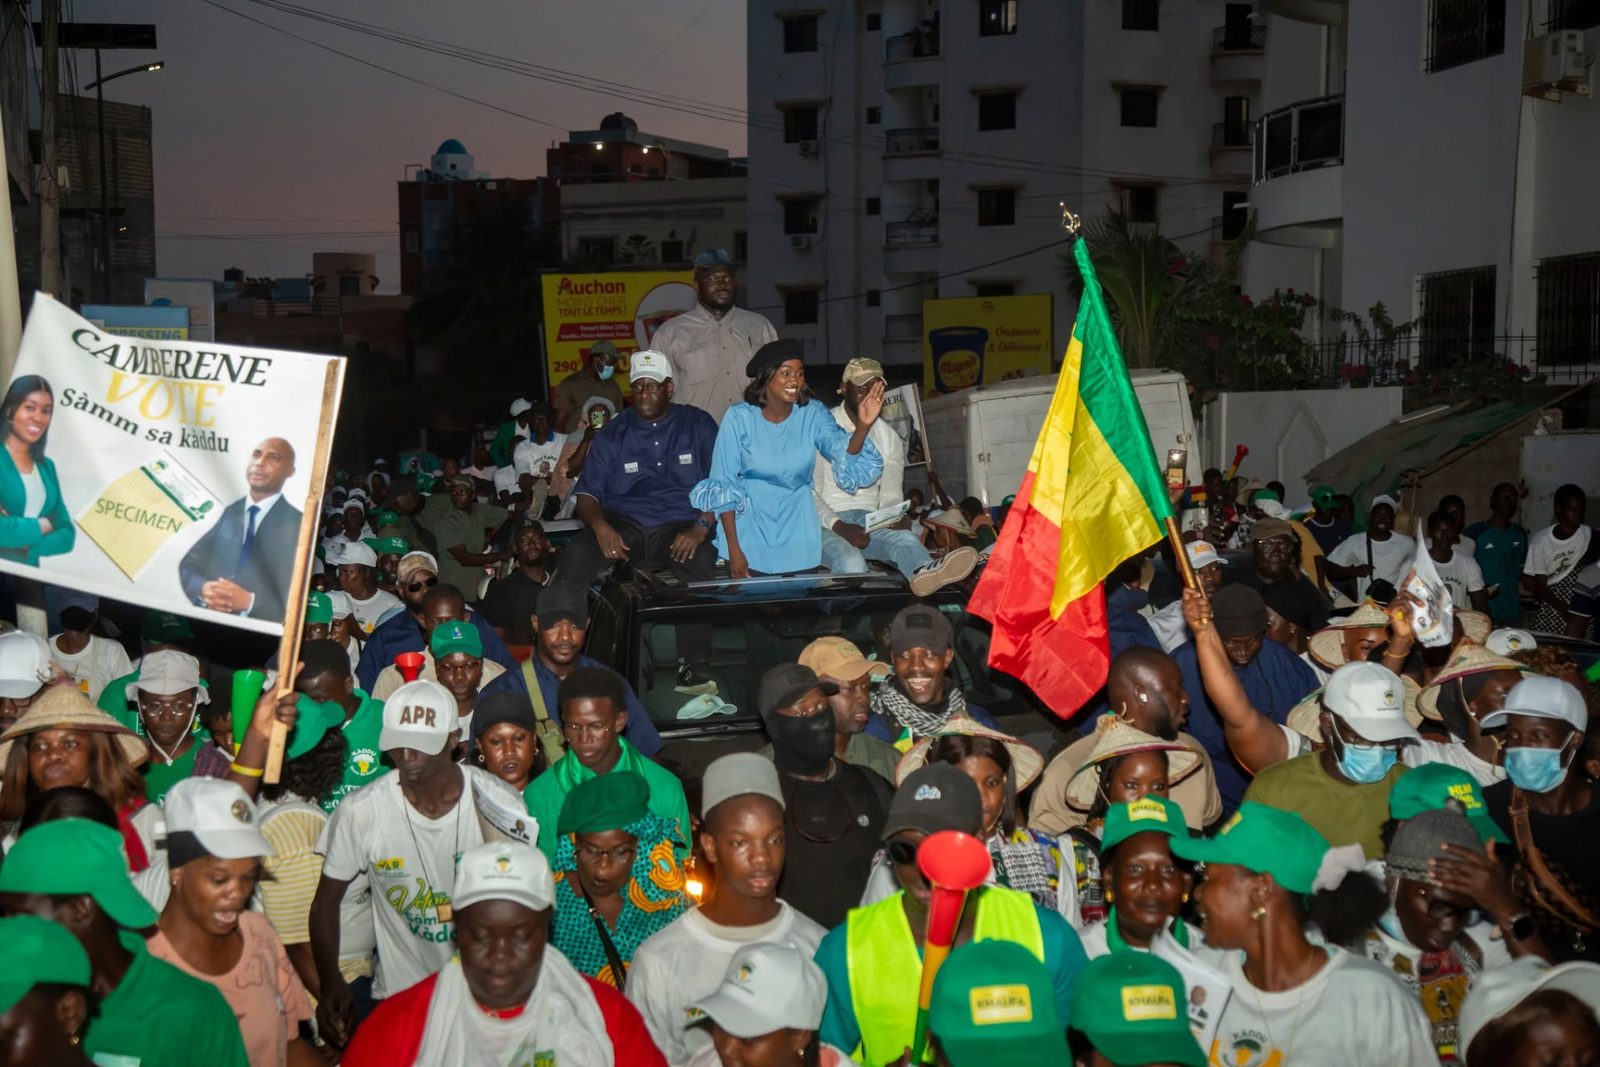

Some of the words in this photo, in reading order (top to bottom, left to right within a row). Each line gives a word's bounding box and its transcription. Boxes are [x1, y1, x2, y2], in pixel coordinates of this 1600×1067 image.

[557, 277, 625, 295] Auchan
[559, 307, 581, 316] TOUT
[584, 307, 592, 316] LE
[595, 307, 622, 316] TEMPS
[71, 328, 272, 387] CAMBERENE
[104, 372, 224, 428] VOTE
[60, 388, 139, 436] Sàmm
[146, 427, 173, 446] sa
[178, 427, 230, 453] kàddu
[95, 497, 183, 534] SPECIMEN
[400, 705, 436, 728] APR
